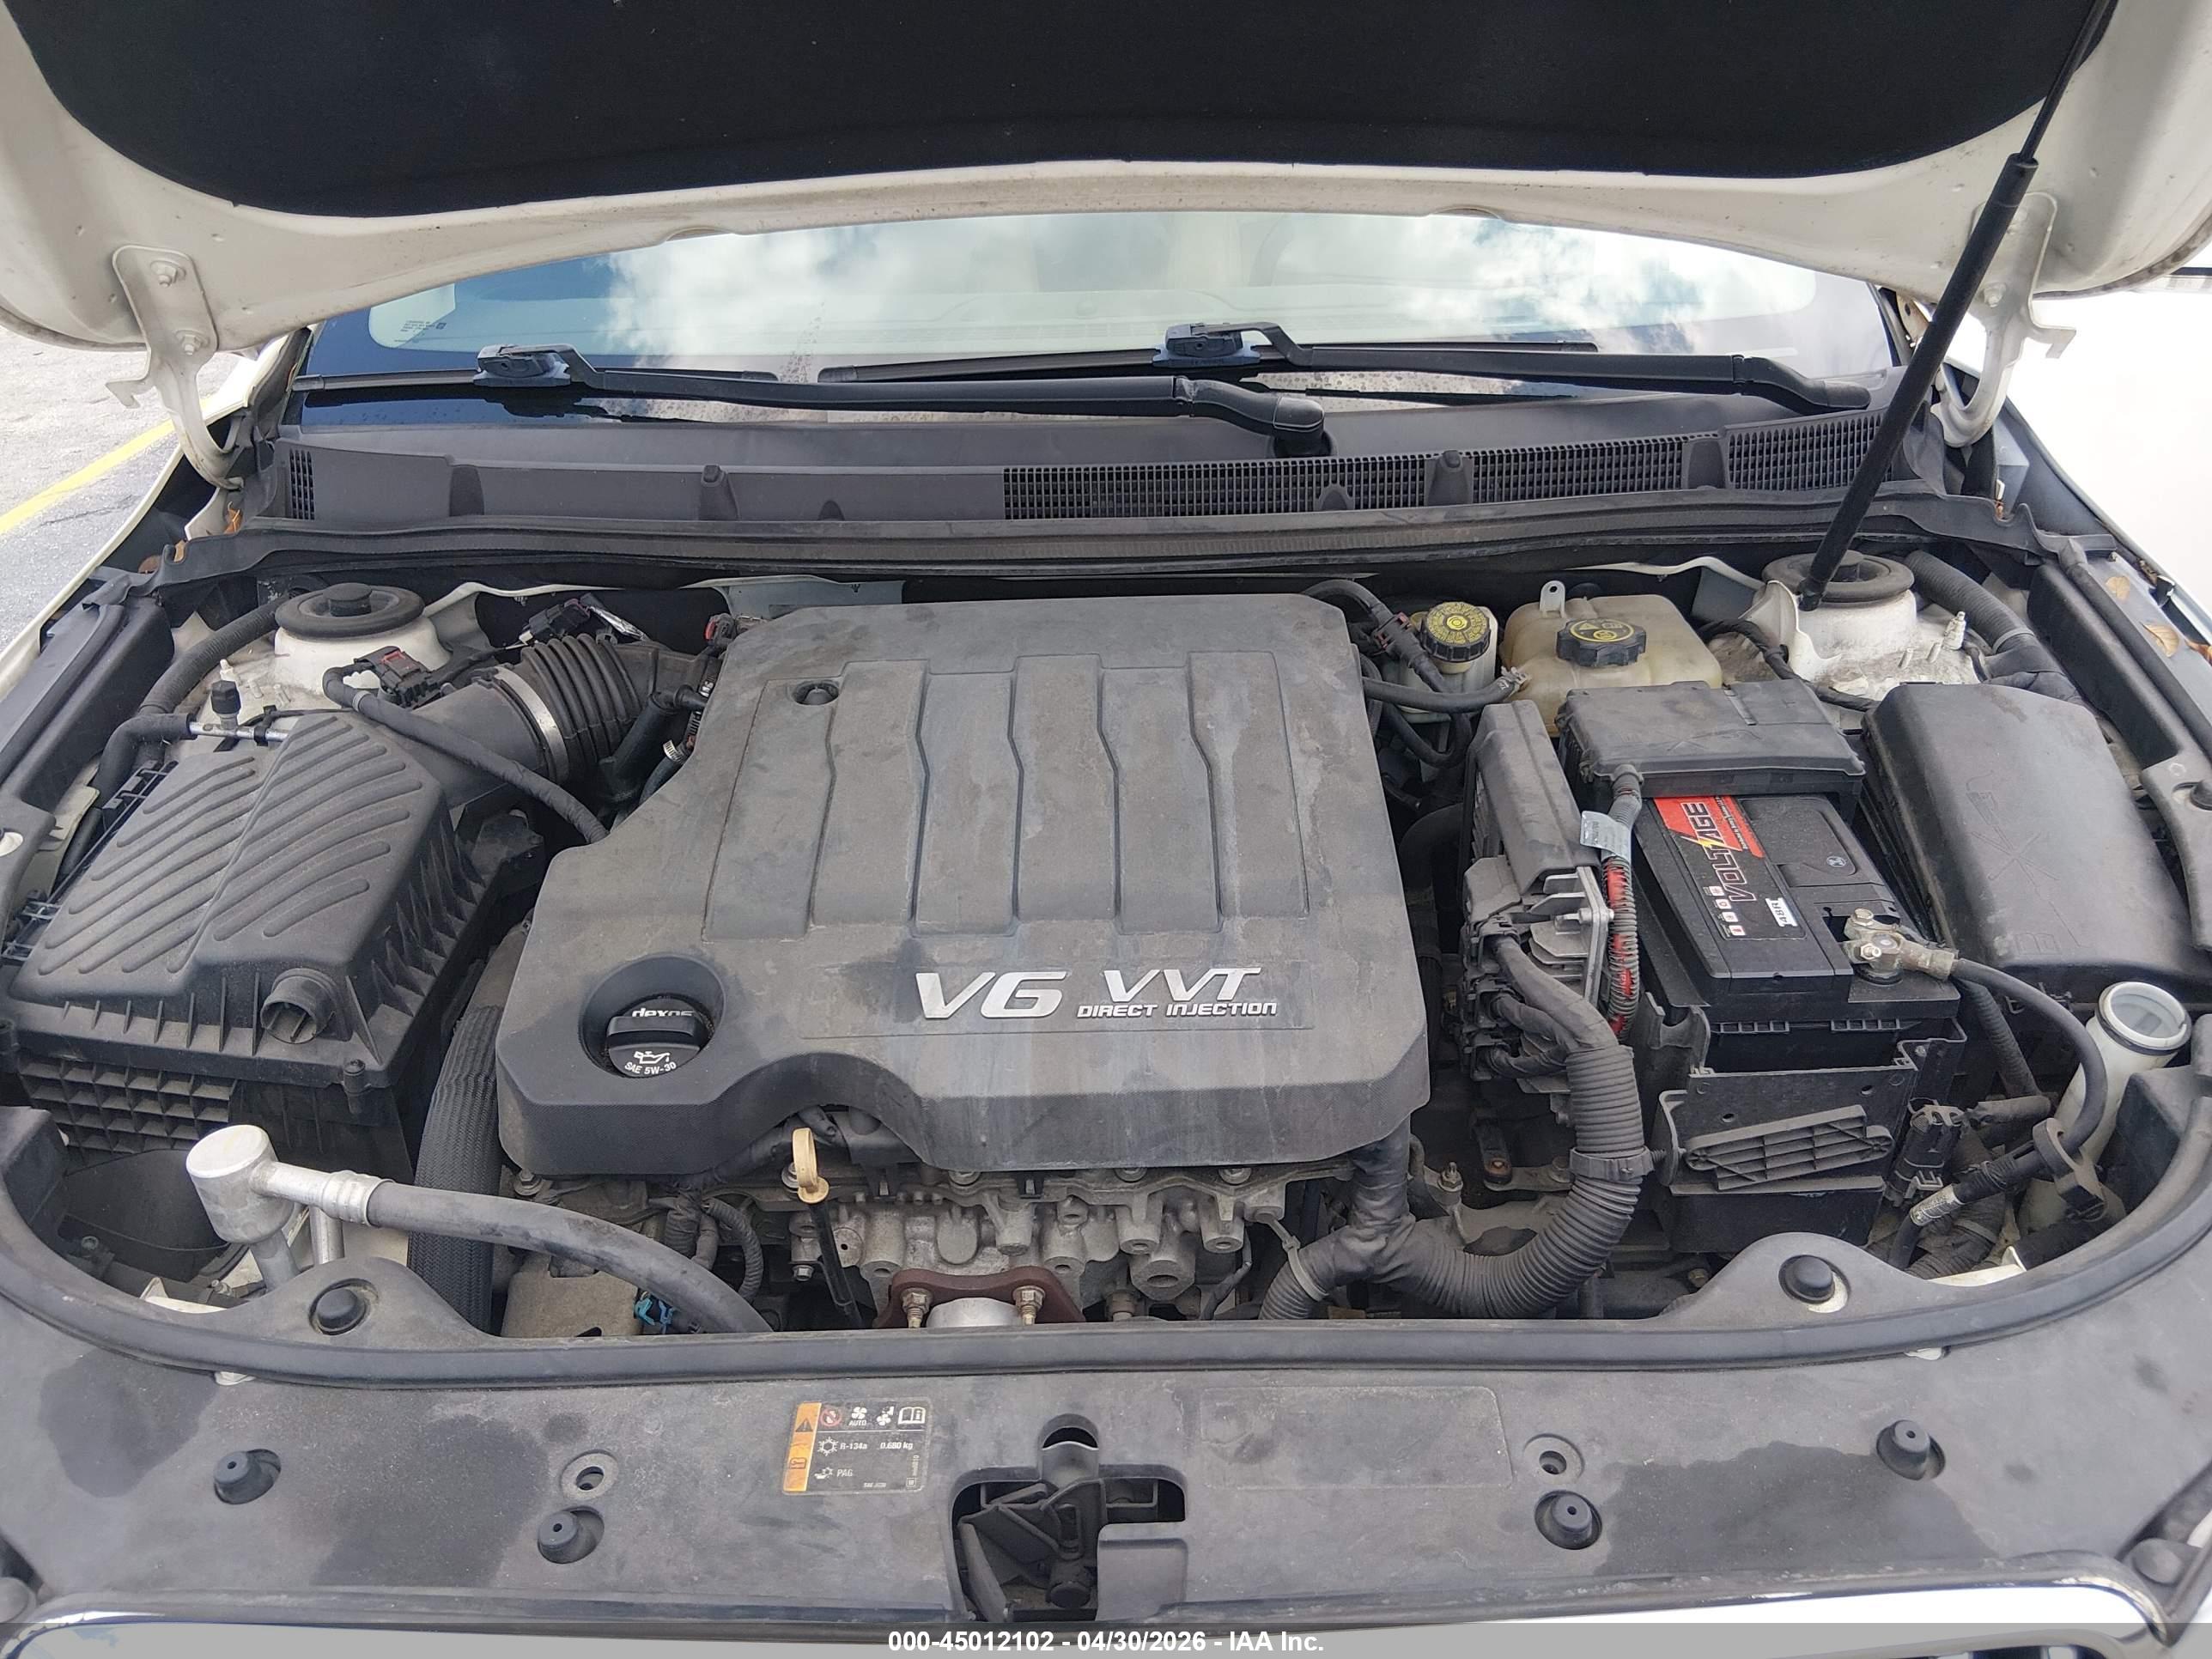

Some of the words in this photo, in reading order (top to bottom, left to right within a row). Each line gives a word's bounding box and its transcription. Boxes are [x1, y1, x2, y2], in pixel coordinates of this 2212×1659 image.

[1771, 902, 1788, 923] 48R
[915, 971, 1066, 1018] V6
[1103, 967, 1261, 1002] VVT
[1077, 1004, 1158, 1018] DIRECT
[1165, 1002, 1277, 1017] INJECTION
[624, 1061, 642, 1073] SAE
[643, 1061, 677, 1074] 5W-30
[836, 1468, 854, 1477] PAG
